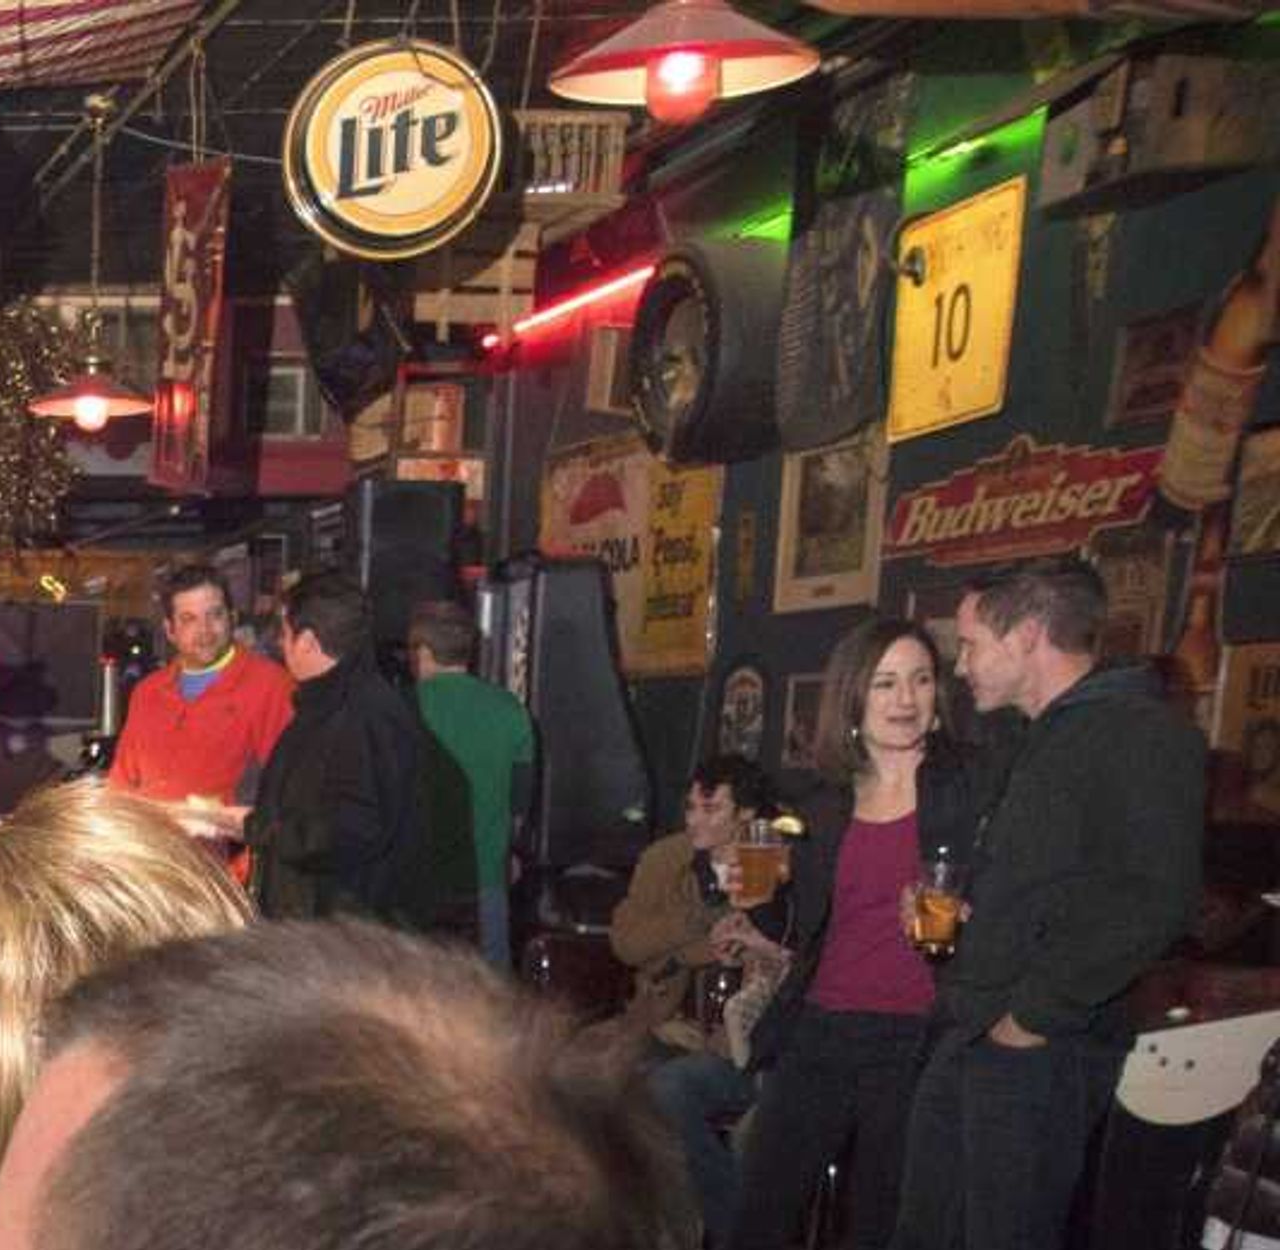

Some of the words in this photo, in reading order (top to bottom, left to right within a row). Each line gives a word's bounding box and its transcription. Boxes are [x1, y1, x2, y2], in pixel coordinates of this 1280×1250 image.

[337, 110, 458, 199] Lite
[931, 282, 972, 370] 10
[896, 471, 1142, 546] Budweiser
